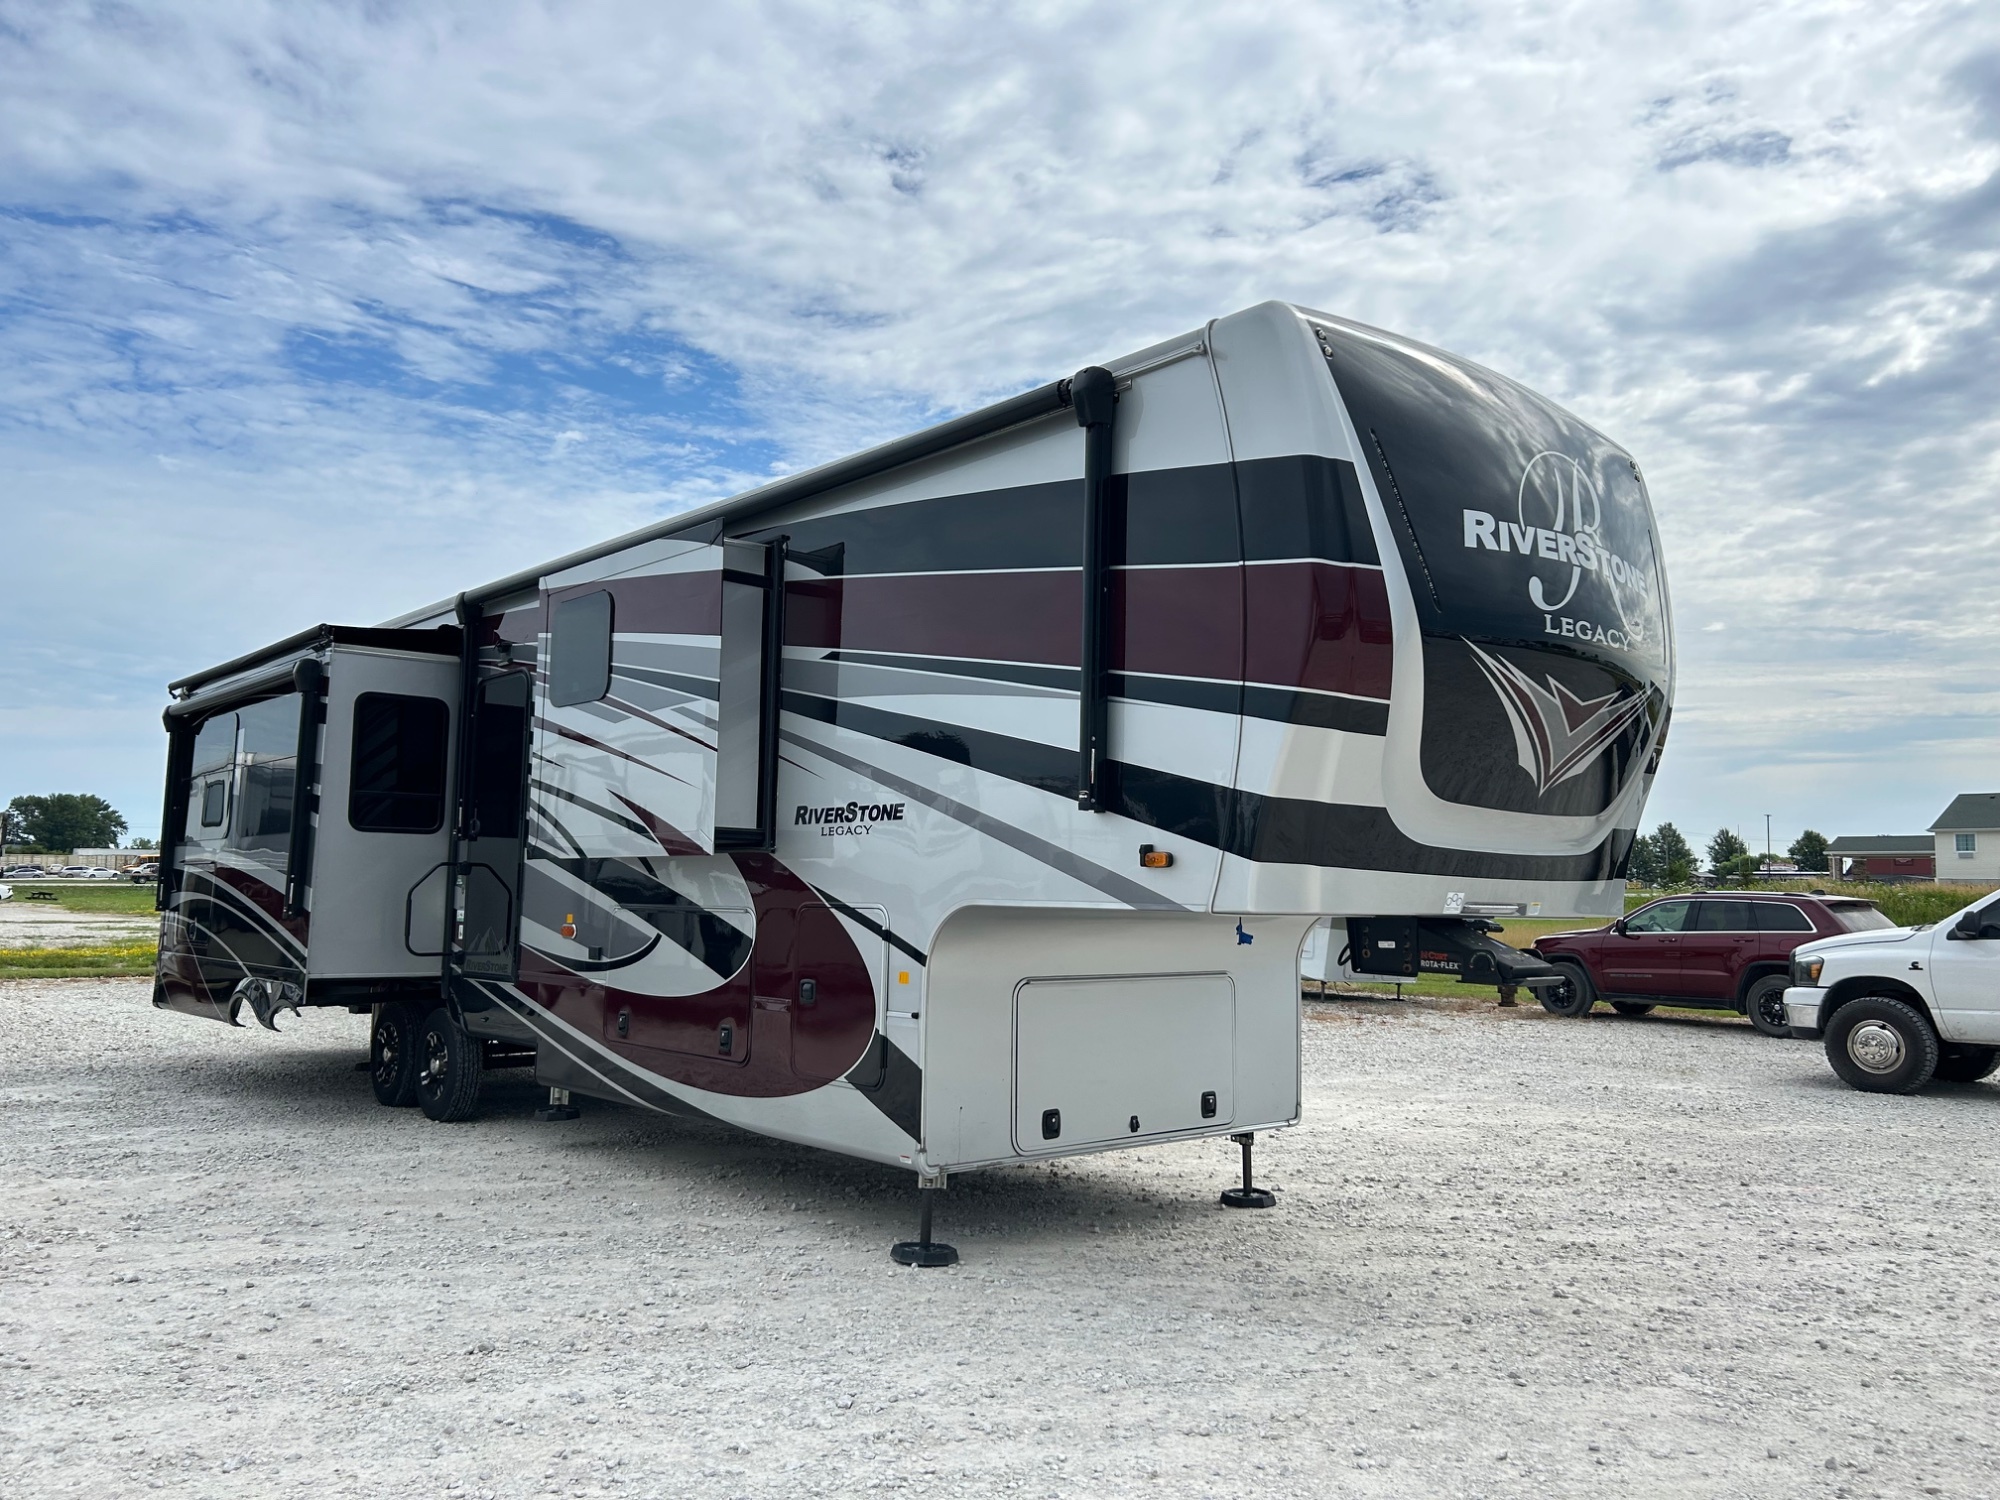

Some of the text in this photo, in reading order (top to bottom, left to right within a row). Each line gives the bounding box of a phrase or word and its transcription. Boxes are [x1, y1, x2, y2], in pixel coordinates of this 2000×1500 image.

[1462, 509, 1648, 598] RIVERSTONE
[1544, 614, 1631, 651] LEGACY
[794, 801, 905, 825] RIVERSTONE
[821, 825, 873, 836] LEGACY
[1420, 960, 1459, 970] ROTA-FLEX
